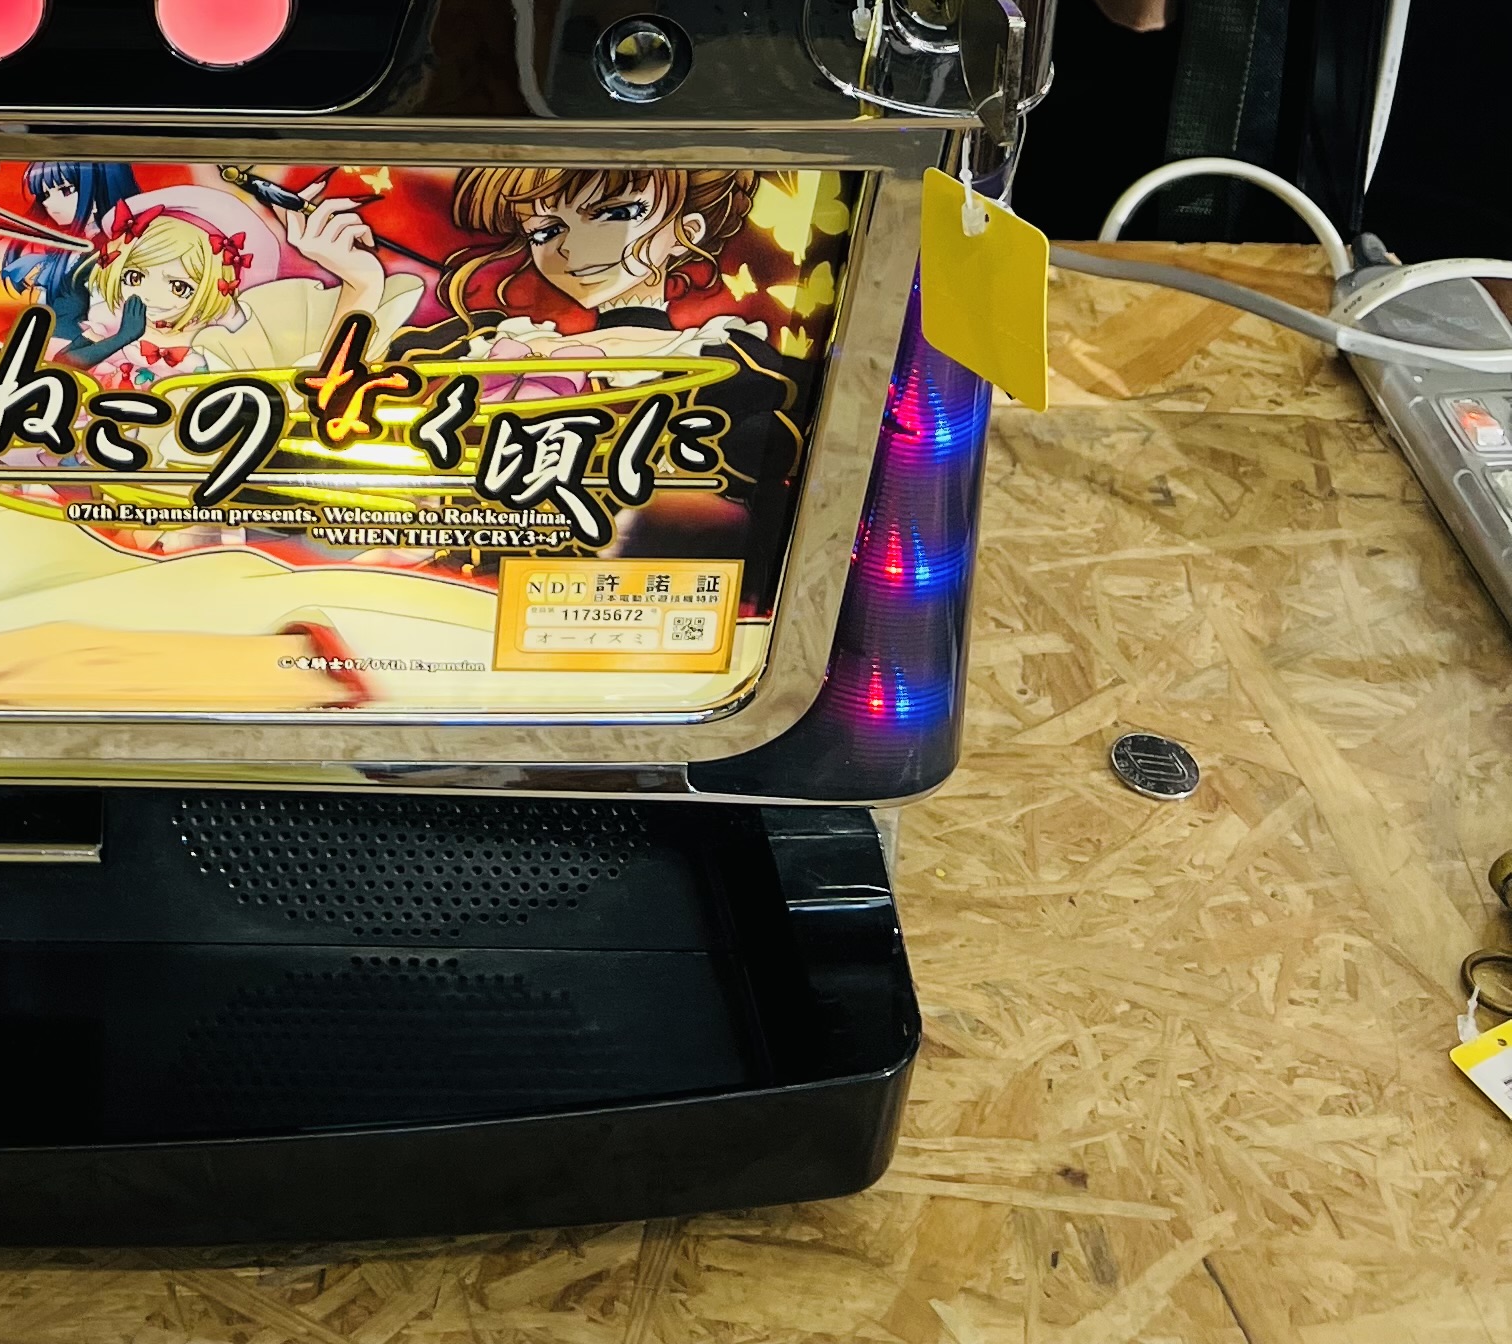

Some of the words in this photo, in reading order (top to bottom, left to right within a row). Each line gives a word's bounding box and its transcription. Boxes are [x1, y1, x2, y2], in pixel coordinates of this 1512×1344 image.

[68, 504, 113, 522] 07th
[119, 504, 223, 526] Expansion
[229, 505, 318, 526] presents.
[324, 506, 414, 524] Welcome
[419, 507, 441, 524] to
[444, 507, 572, 528] Rokkenjima.
[312, 528, 400, 546] "WHEN
[401, 529, 471, 546] THEY
[473, 529, 572, 547] CRY3+4"
[595, 574, 721, 593] 許諾証
[562, 609, 644, 622] 11735672
[537, 631, 643, 645] オーイズミ
[409, 659, 486, 672] Expansion
